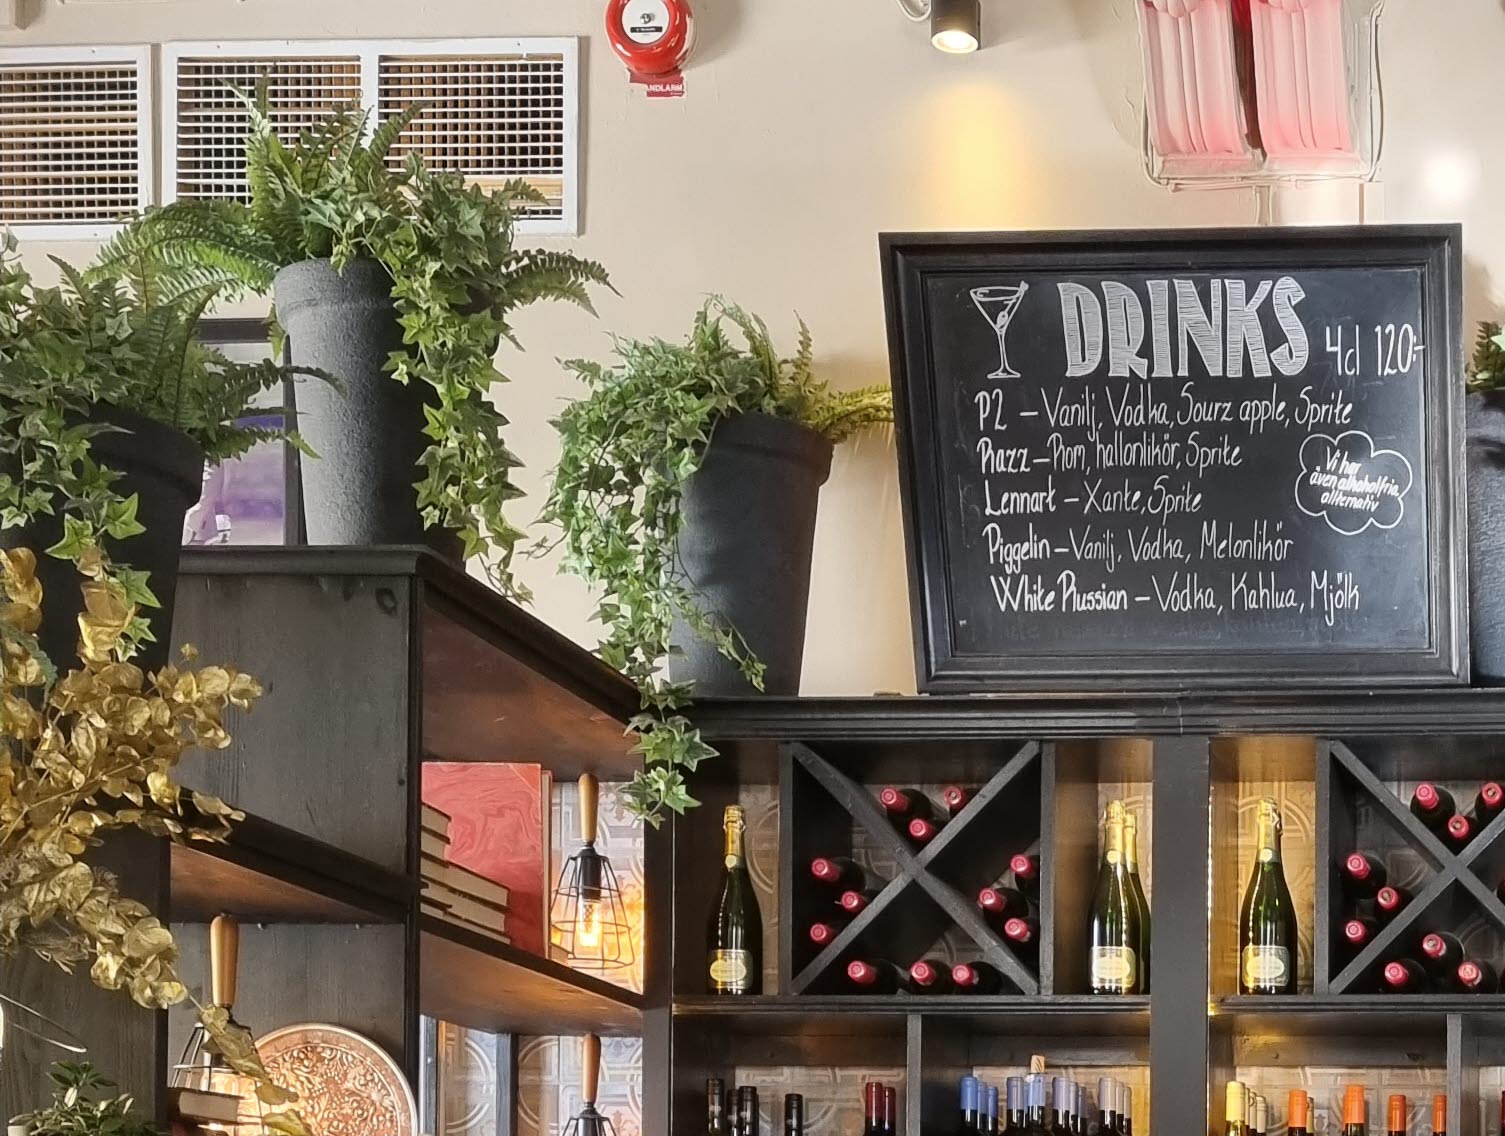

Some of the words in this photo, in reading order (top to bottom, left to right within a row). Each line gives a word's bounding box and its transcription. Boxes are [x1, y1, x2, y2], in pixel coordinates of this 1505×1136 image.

[1056, 276, 1309, 379] DRINKS
[974, 388, 1008, 431] P2
[1105, 382, 1174, 429] Vodka,
[1176, 381, 1234, 425] Sourz
[1239, 382, 1290, 434] apple,
[1294, 386, 1353, 432] Sprite
[1185, 431, 1242, 478] Sprite
[985, 474, 1056, 516] Lennart
[1148, 474, 1202, 525] Sprite
[982, 522, 1050, 574] Piggelin
[1200, 519, 1294, 561] Melonlikör
[990, 573, 1056, 612] White
[1056, 570, 1128, 613] Russian
[1151, 570, 1223, 615] Vodka,
[1231, 571, 1305, 614] Kahlua,
[1311, 570, 1360, 626] Mjölk
